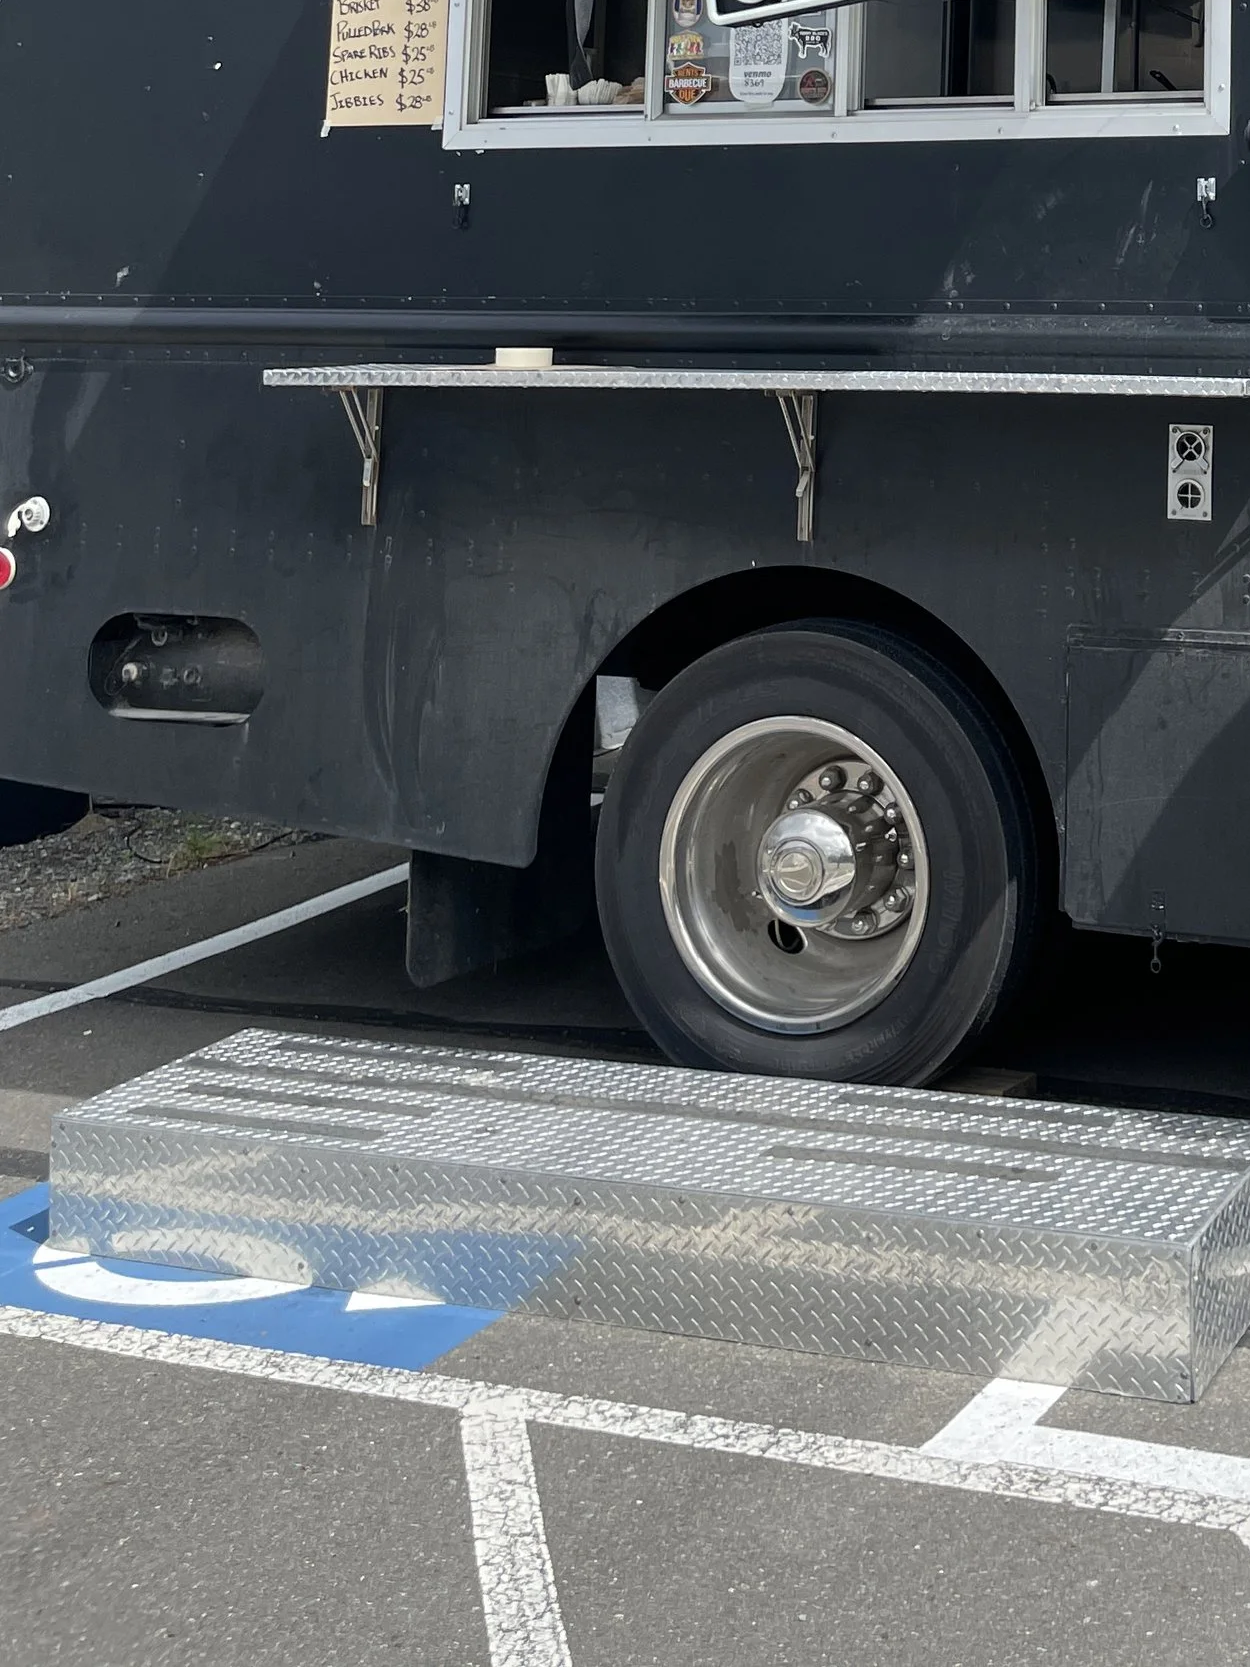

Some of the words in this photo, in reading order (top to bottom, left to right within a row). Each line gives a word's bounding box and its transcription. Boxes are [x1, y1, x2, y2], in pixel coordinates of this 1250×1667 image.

[336, 20, 373, 43] PULLED
[332, 46, 368, 64] SPARE
[368, 44, 396, 60] RIBS
[330, 67, 388, 86] CHICKEN
[668, 78, 707, 88] BARBECUE
[330, 92, 384, 111] JIBBIES
[679, 89, 696, 102] DUE
